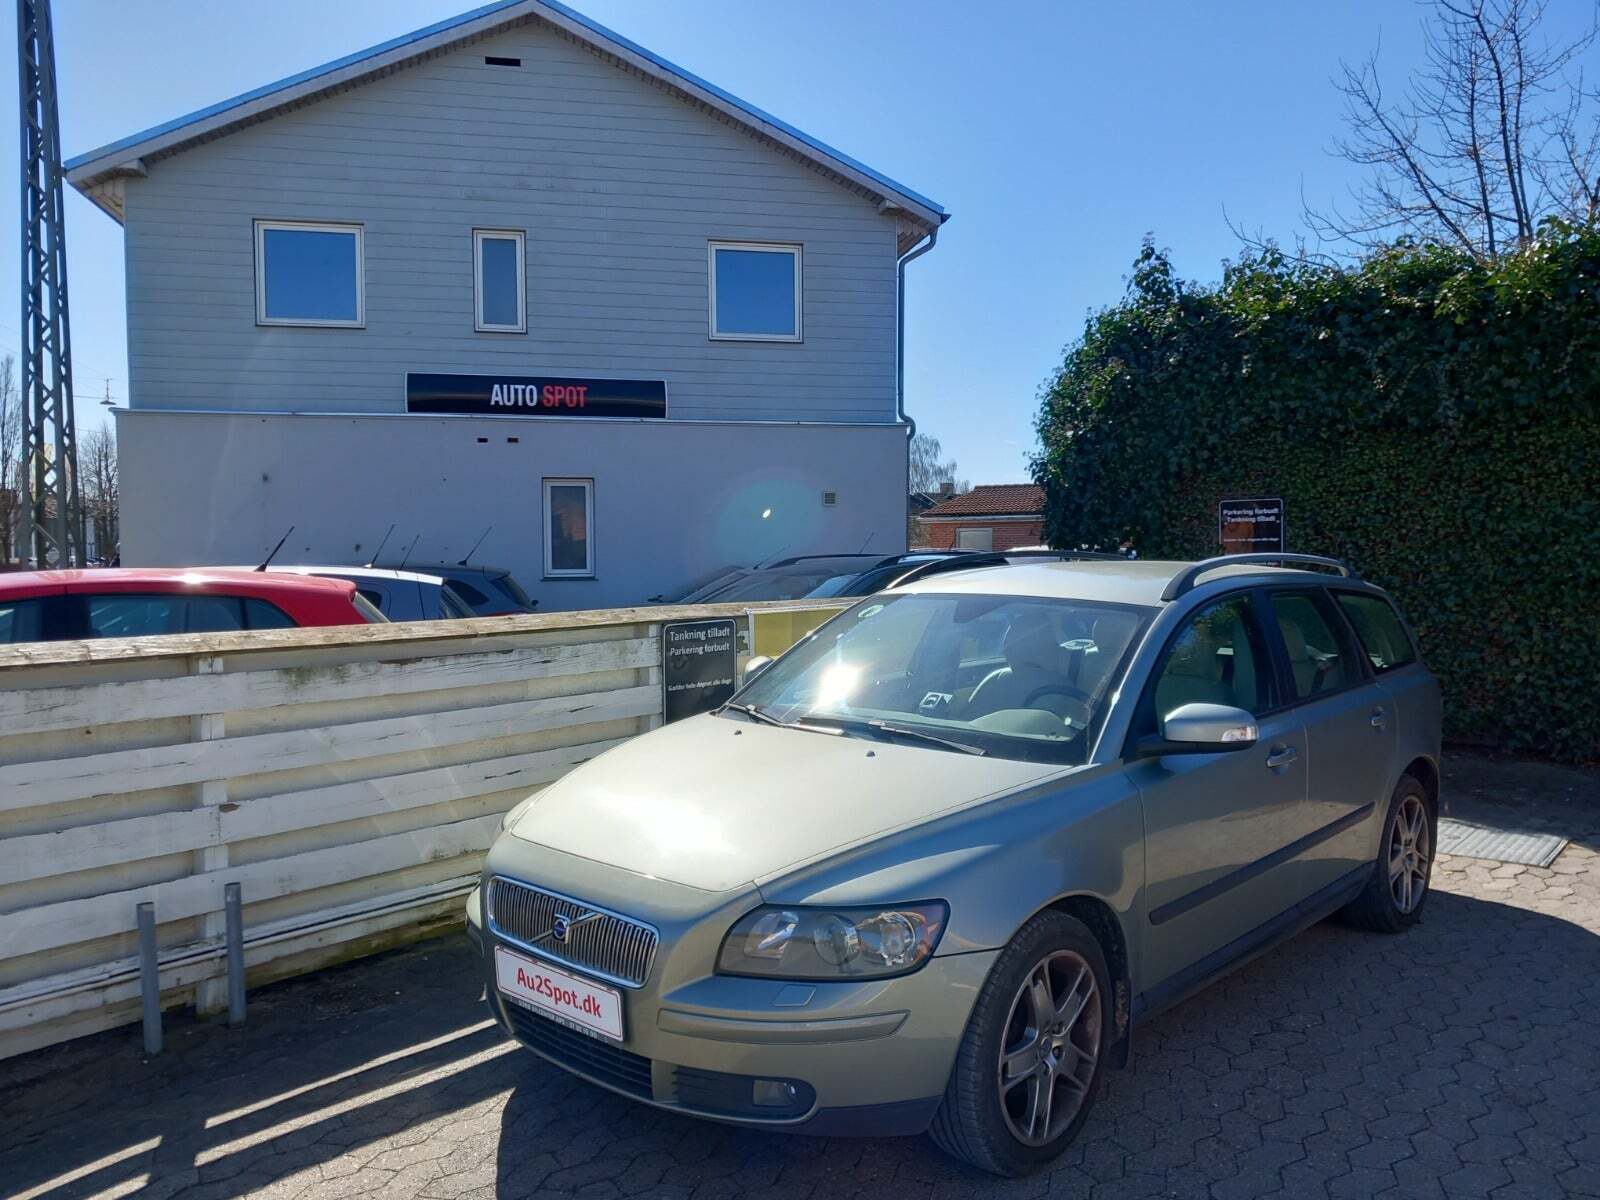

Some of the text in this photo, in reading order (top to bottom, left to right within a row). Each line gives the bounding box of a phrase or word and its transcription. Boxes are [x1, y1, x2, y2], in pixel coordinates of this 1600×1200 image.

[490, 384, 587, 408] AUTO SPOT
[670, 627, 730, 641] Tankning tilladt
[670, 642, 730, 656] Parkering forbudt
[517, 967, 602, 1018] Au2Spot.dk
